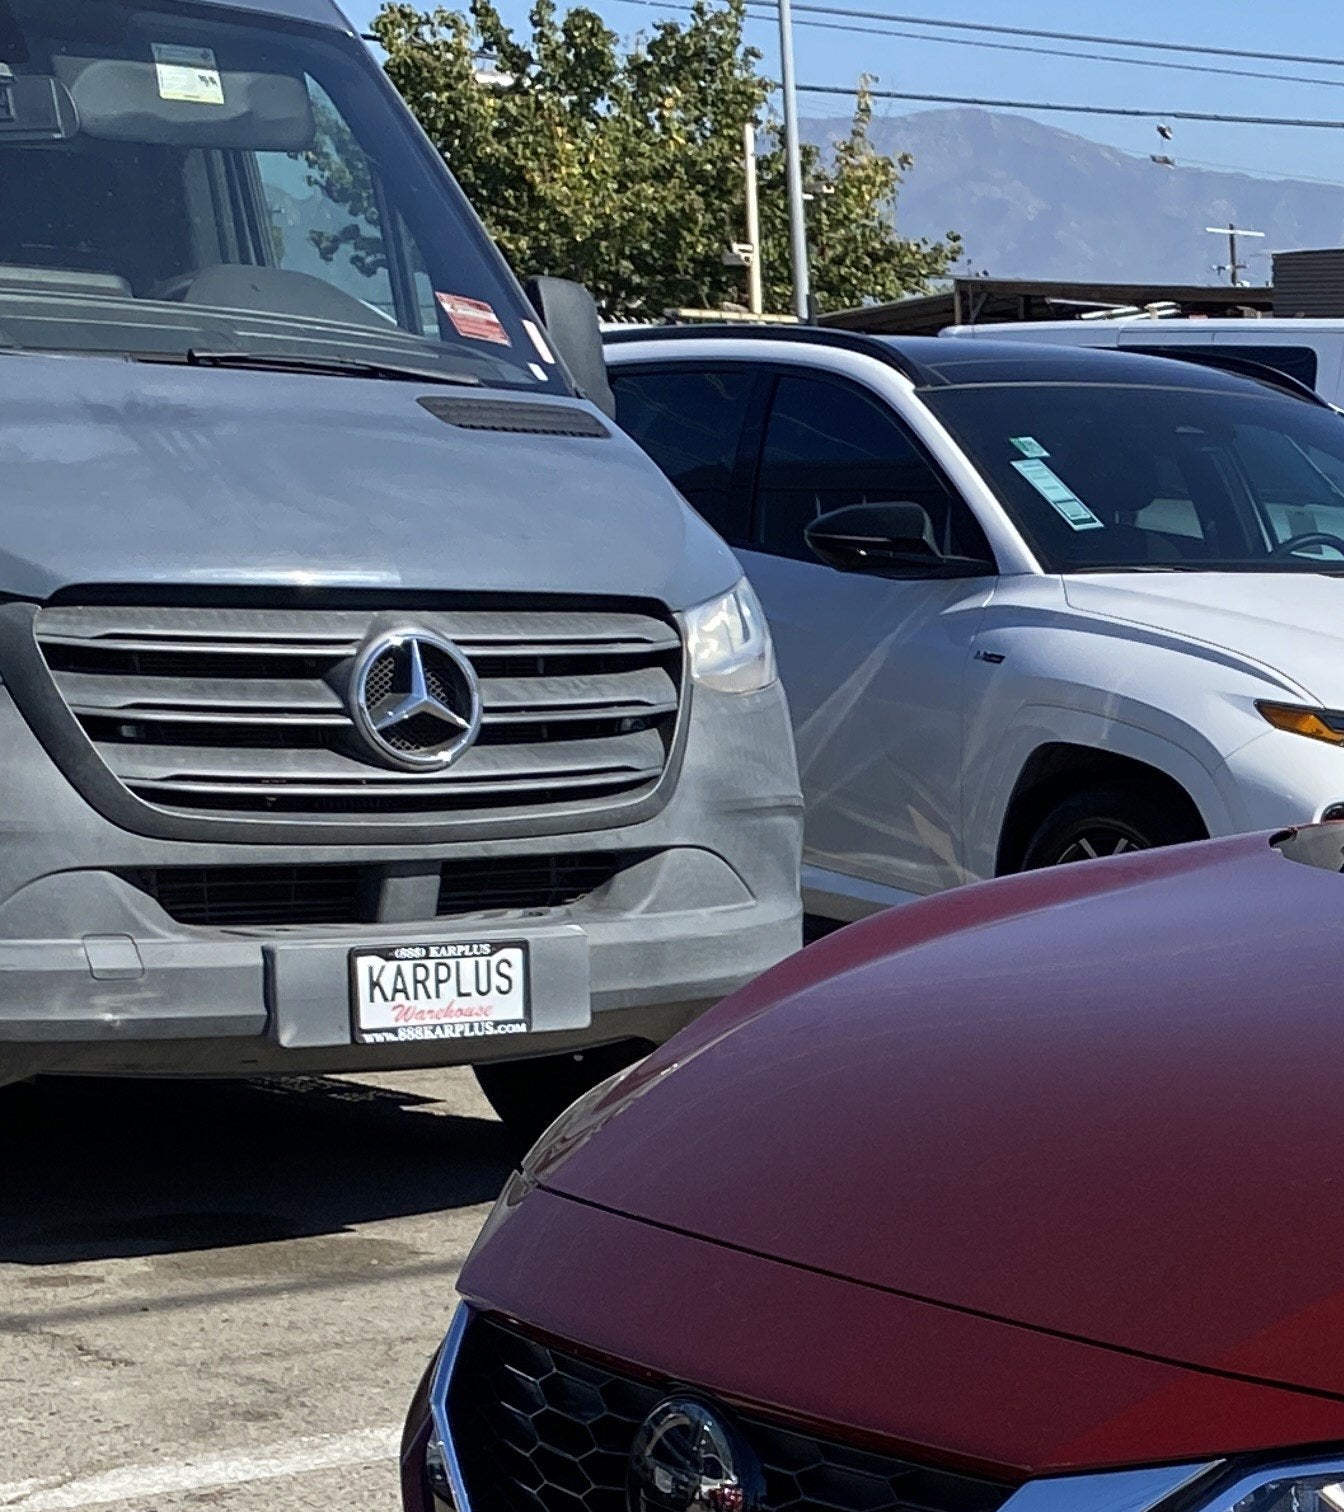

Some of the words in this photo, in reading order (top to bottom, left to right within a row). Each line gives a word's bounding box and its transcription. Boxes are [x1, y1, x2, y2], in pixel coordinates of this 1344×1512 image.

[429, 944, 491, 957] KARPLUS
[368, 958, 513, 1003] KARPLUS
[391, 999, 494, 1023] Warehouse
